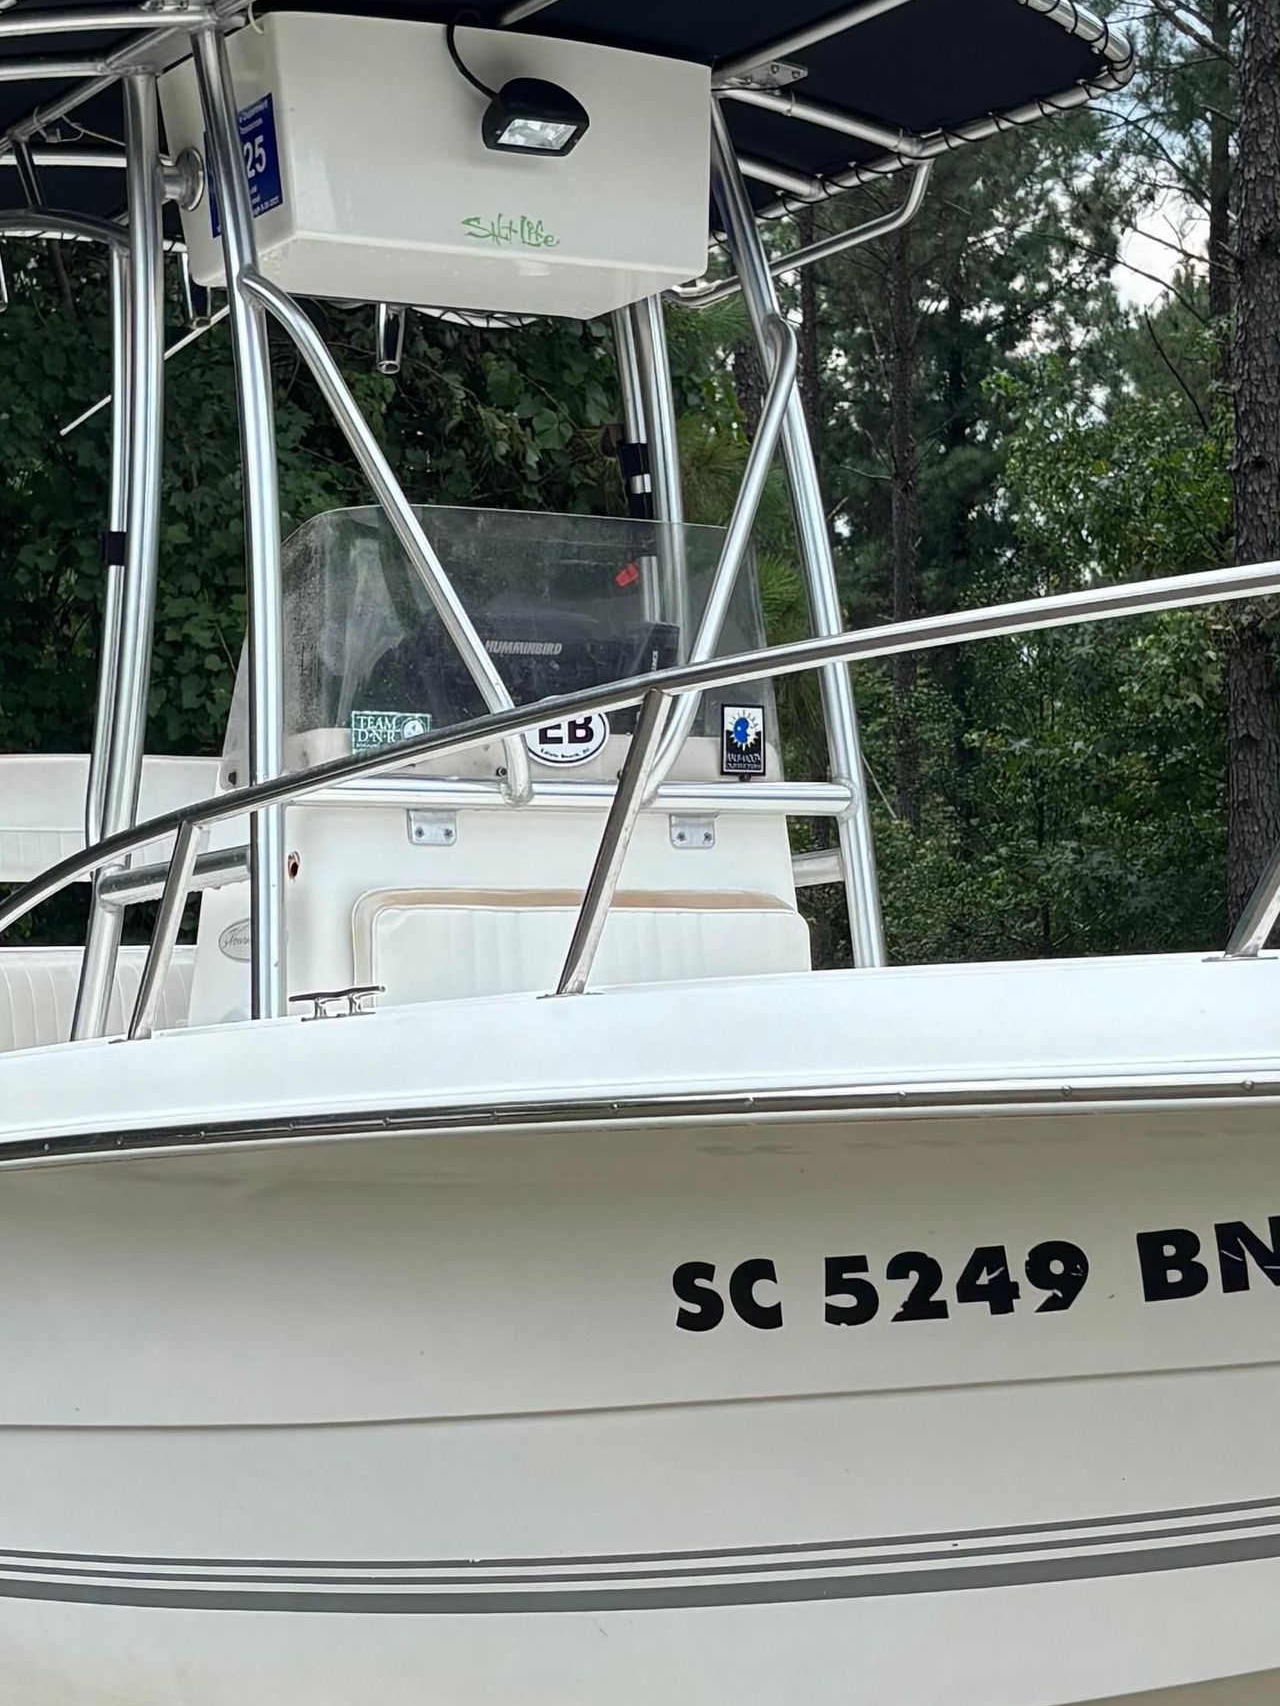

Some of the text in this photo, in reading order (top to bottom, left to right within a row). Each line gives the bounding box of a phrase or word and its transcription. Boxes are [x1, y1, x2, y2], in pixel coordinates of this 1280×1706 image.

[243, 135, 267, 178] 25
[485, 640, 563, 655] HUMMINBIRD
[357, 716, 397, 730] TEAM
[672, 1258, 784, 1333] SC
[824, 1240, 1089, 1327] 5249
